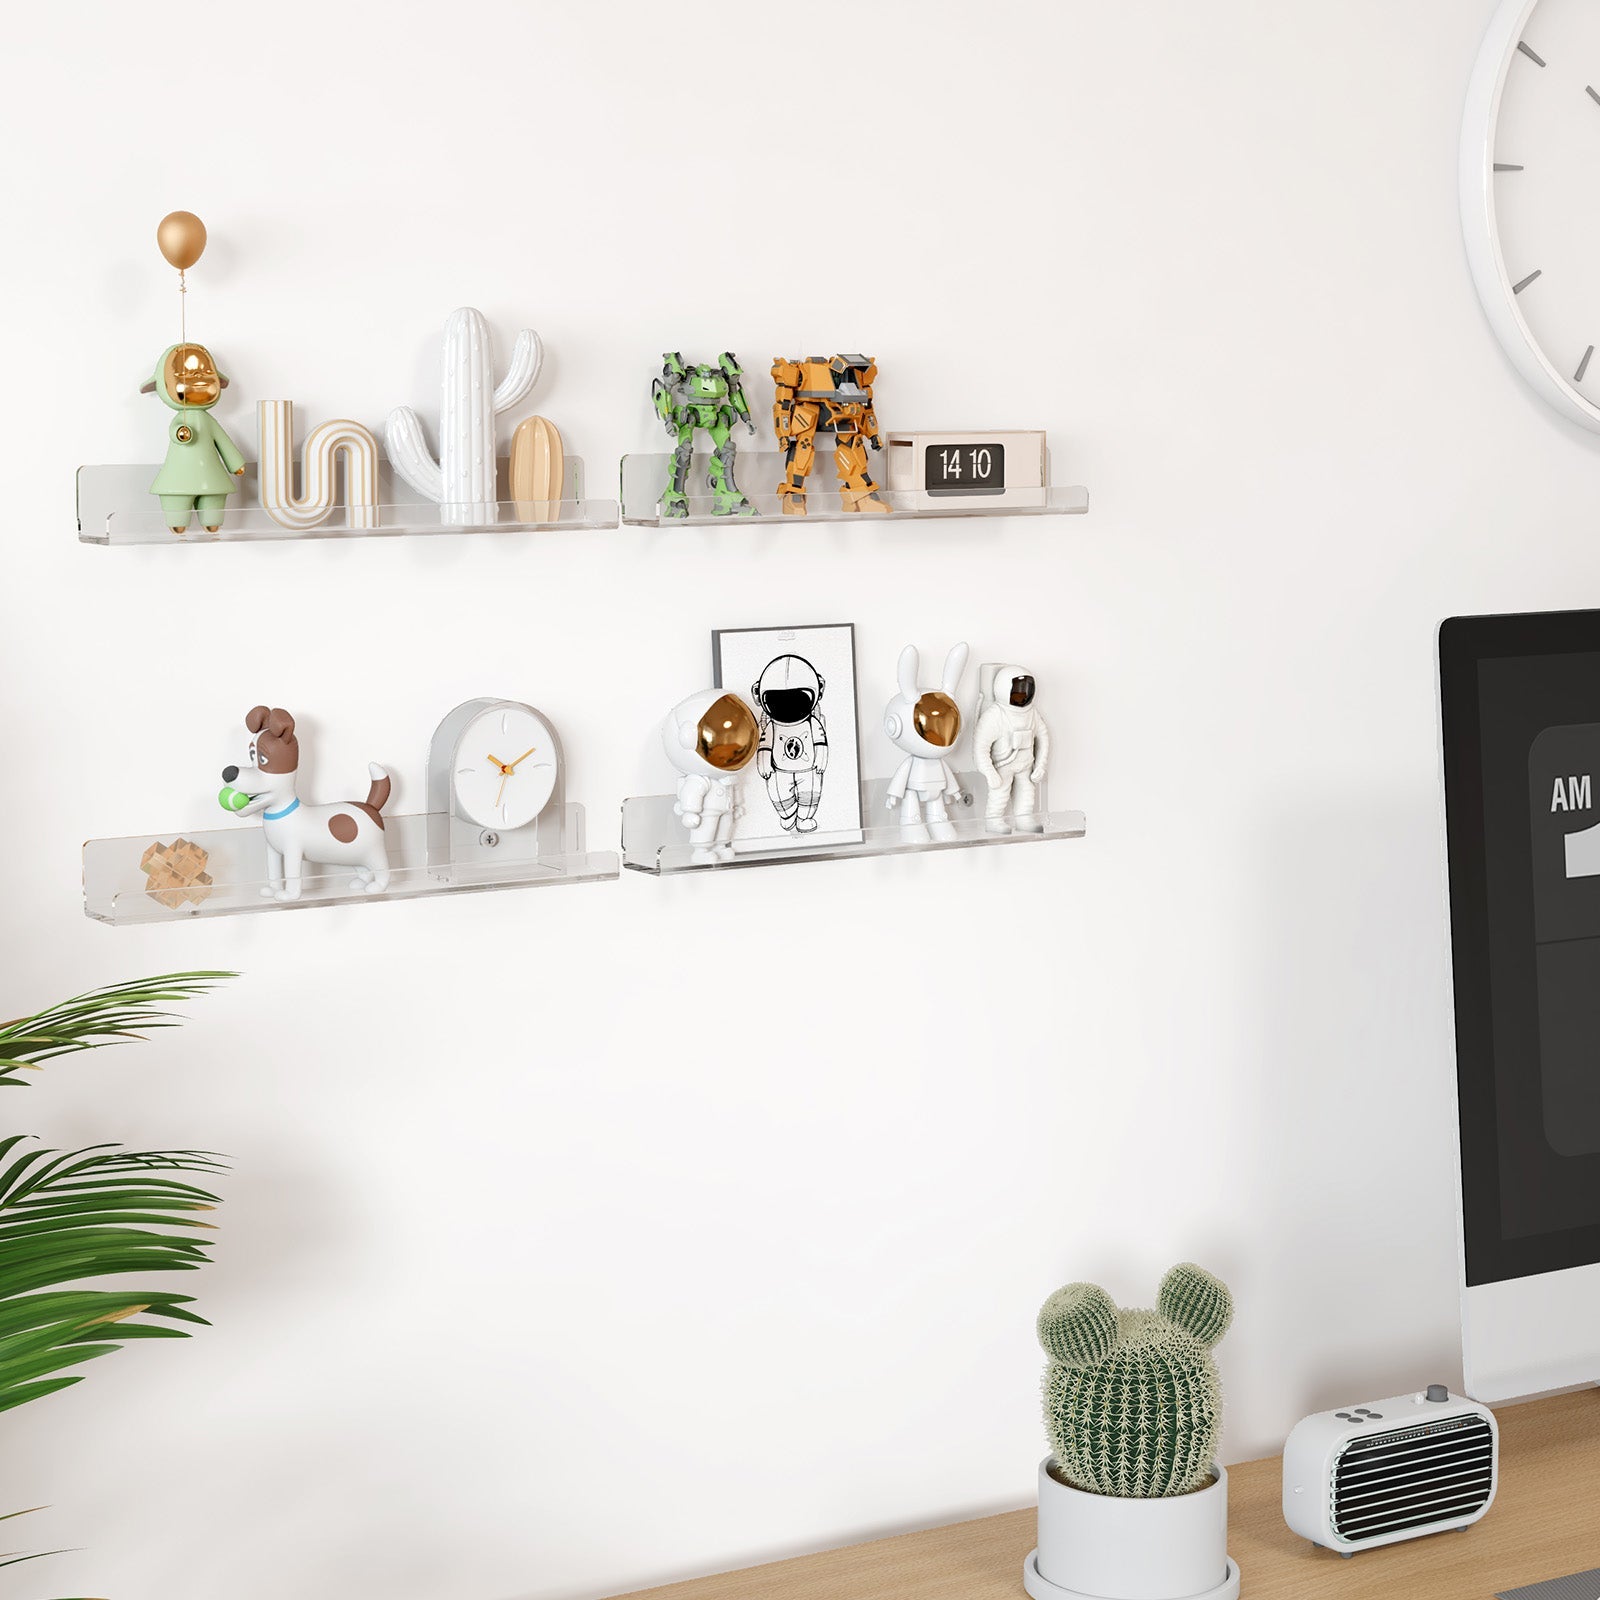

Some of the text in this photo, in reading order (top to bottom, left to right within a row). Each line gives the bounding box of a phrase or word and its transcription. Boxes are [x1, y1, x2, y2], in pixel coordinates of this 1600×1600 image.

[940, 449, 992, 480] 14 10
[1550, 775, 1592, 812] AM
